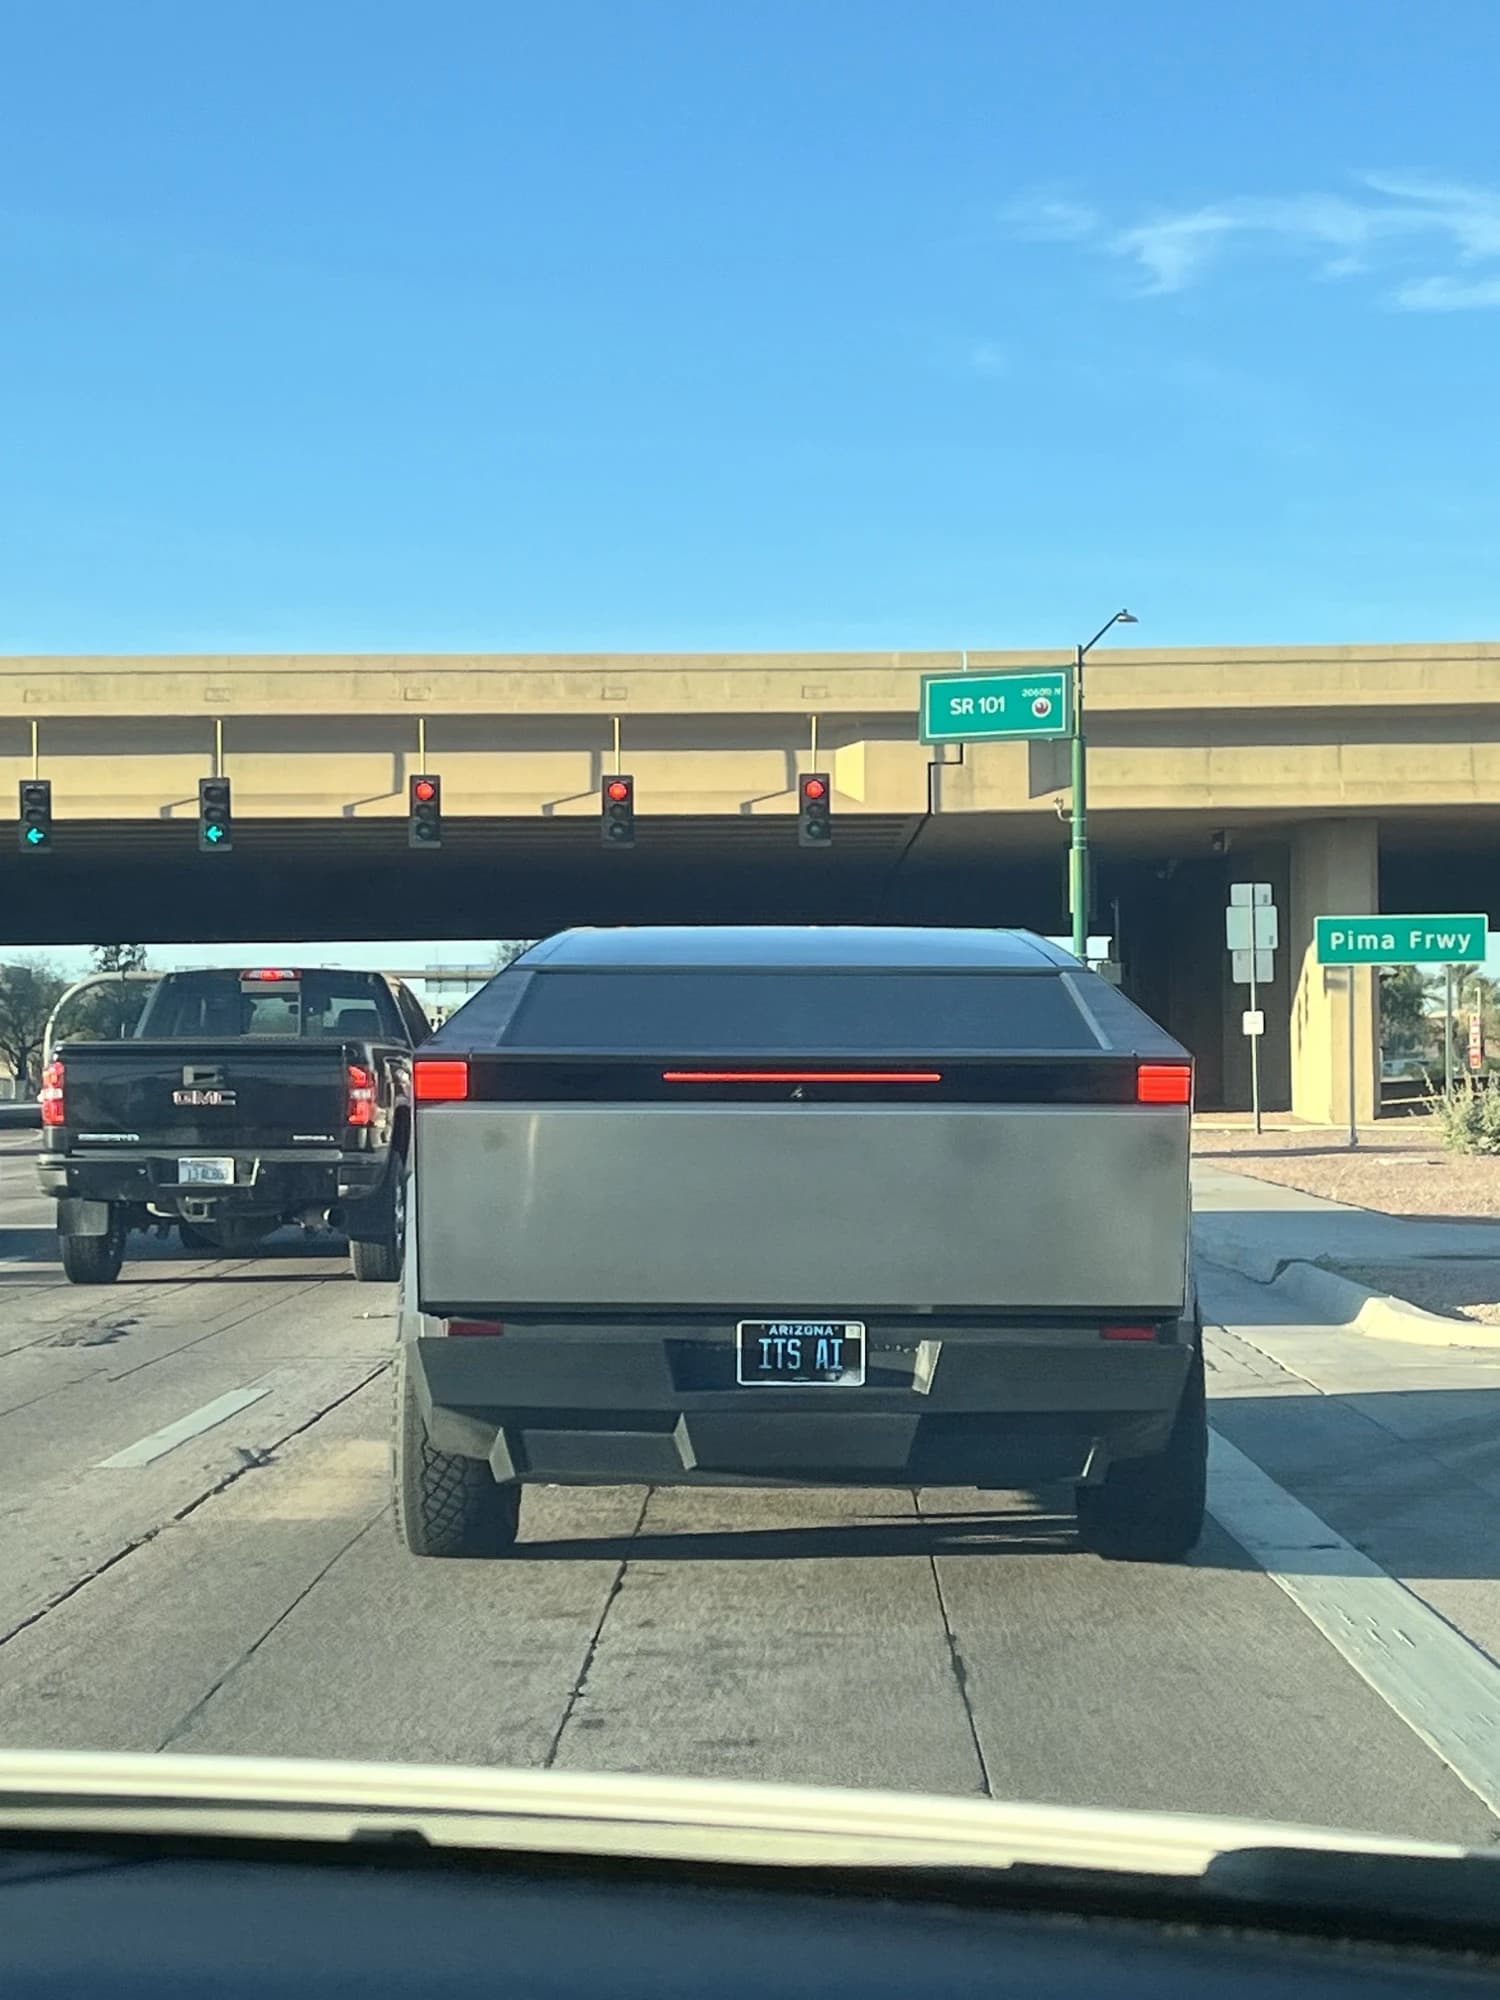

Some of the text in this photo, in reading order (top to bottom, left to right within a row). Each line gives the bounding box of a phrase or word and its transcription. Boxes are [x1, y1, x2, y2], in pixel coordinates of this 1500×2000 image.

[949, 695, 1006, 715] SR 101
[1330, 930, 1471, 953] Pima Frwy
[172, 1090, 237, 1105] GMC
[768, 1325, 834, 1336] ARIZONA
[758, 1338, 844, 1369] ITS AI
